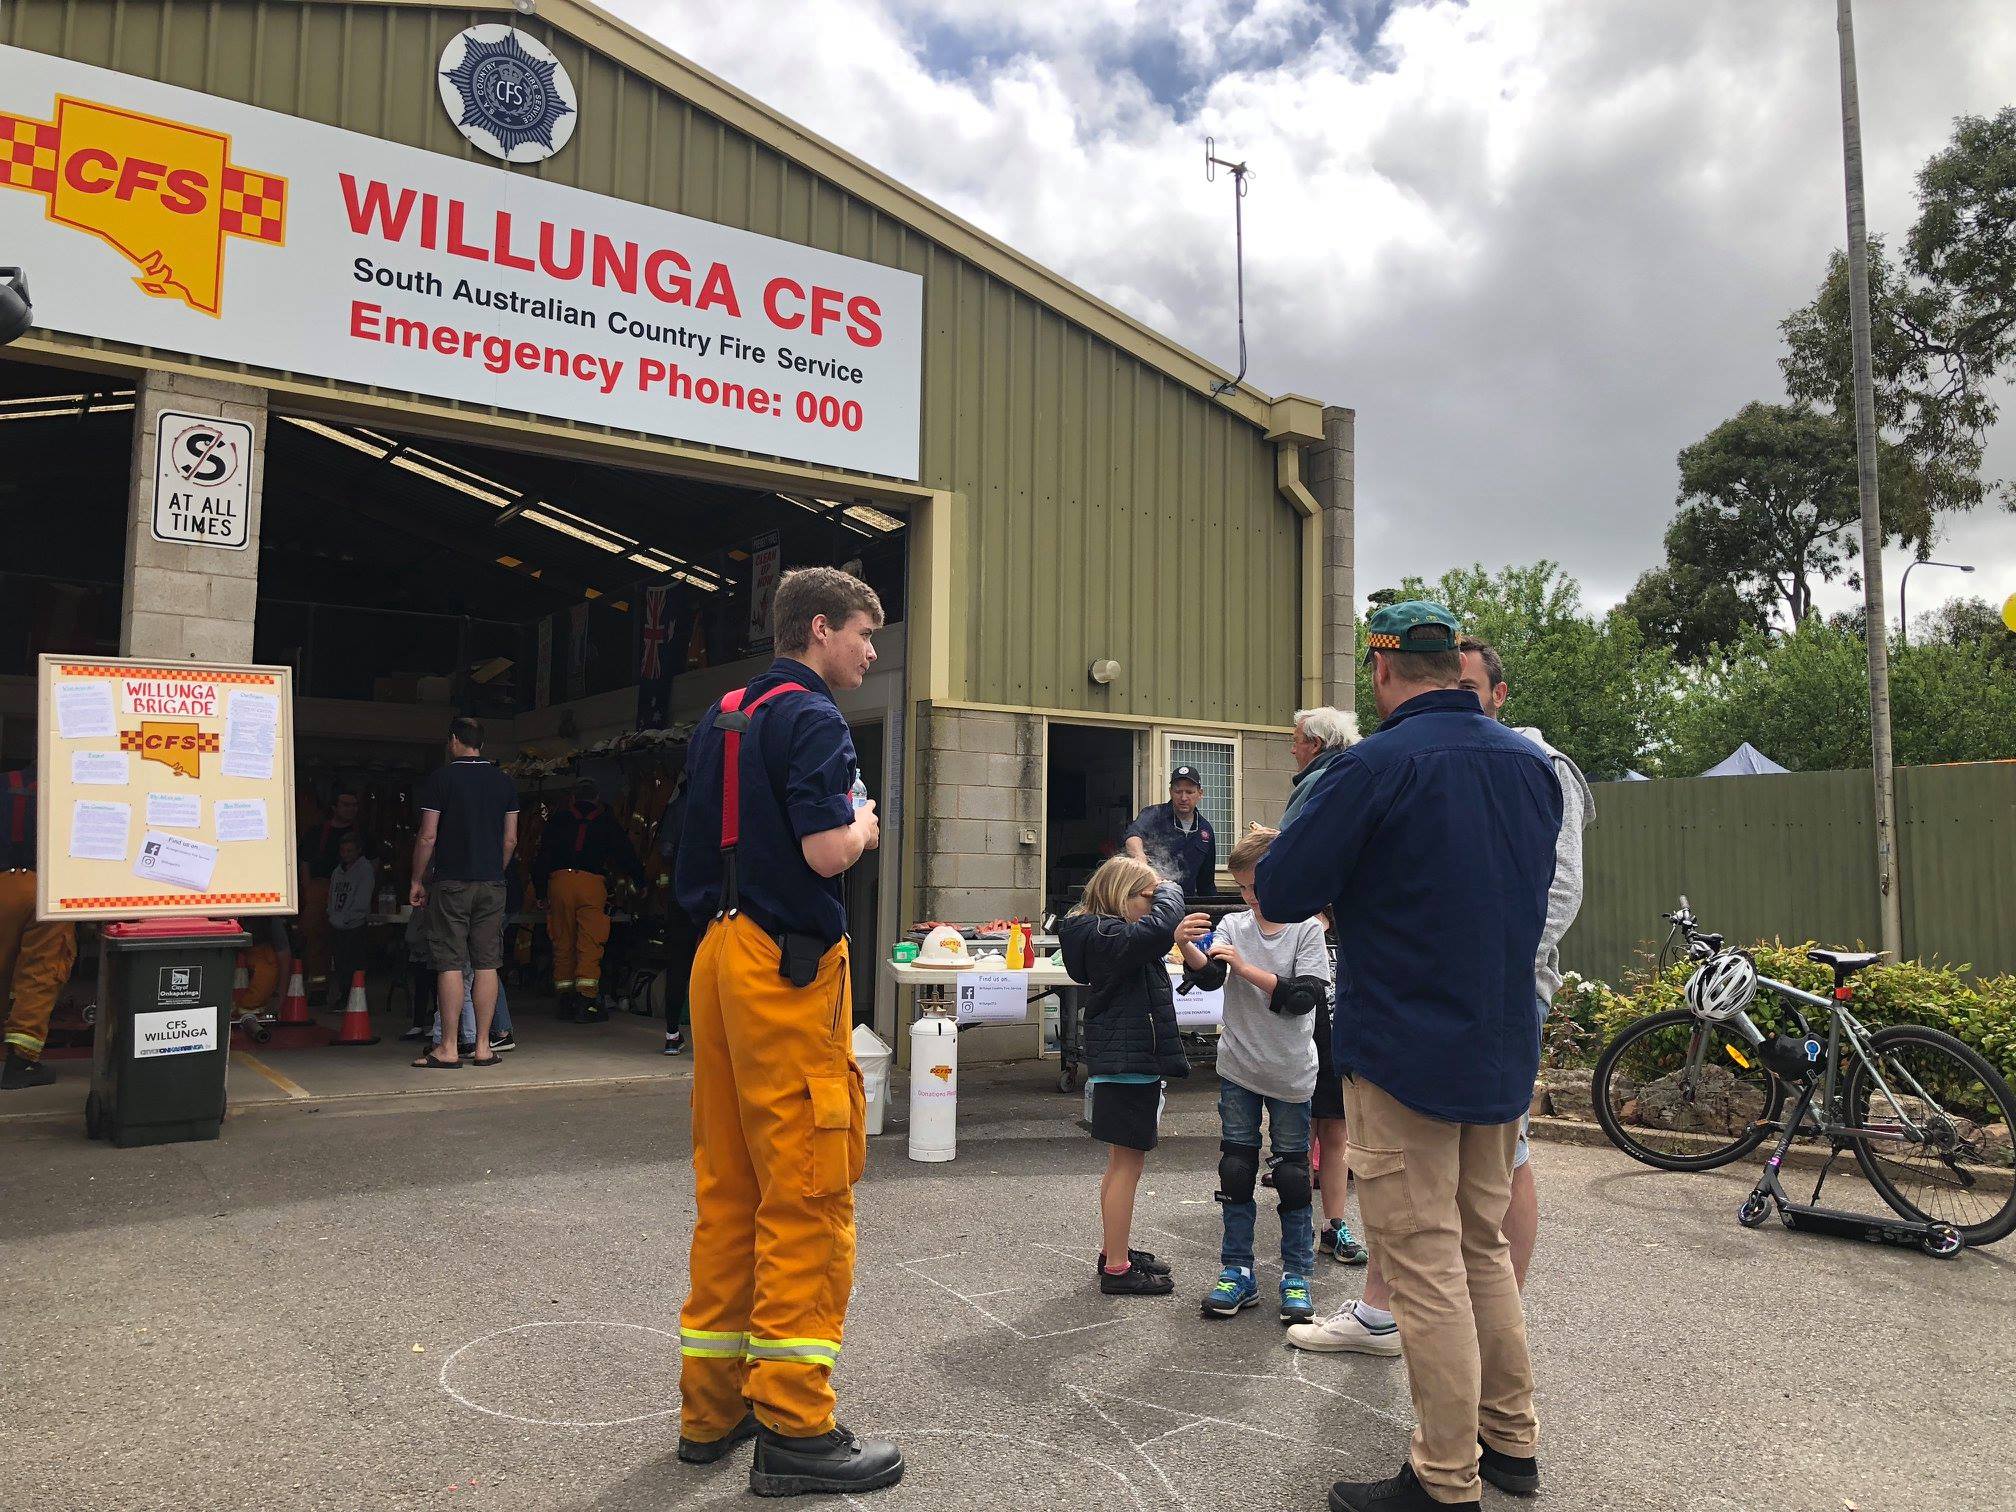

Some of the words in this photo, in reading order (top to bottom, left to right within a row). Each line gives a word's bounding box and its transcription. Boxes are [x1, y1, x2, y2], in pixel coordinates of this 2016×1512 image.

[477, 62, 496, 96] COUNTRY
[524, 72, 539, 90] FIRE
[496, 80, 523, 105] CFS
[522, 94, 541, 124] SERVICE
[64, 148, 209, 215] CFS
[338, 172, 742, 319] WILLUNGA
[763, 277, 884, 348] CFS
[353, 257, 444, 298] South
[452, 279, 597, 329] Australian
[607, 311, 712, 357] Country
[719, 334, 766, 364] Fire
[776, 347, 864, 385] Service
[350, 299, 624, 395] Emergency
[638, 357, 782, 418] Phone:
[796, 390, 864, 433] 000
[169, 492, 194, 512] AT
[201, 496, 237, 518] ALL
[171, 512, 232, 537] TIMES
[756, 549, 776, 566] CLEAN
[126, 681, 216, 700] WILLUNGA
[132, 697, 214, 716] BRIGADE
[145, 734, 197, 751] CFS
[168, 835, 182, 846] Find
[145, 1028, 208, 1042] WILLUNGA
[166, 1020, 187, 1030] CFS
[918, 1090, 946, 1098] Donations
